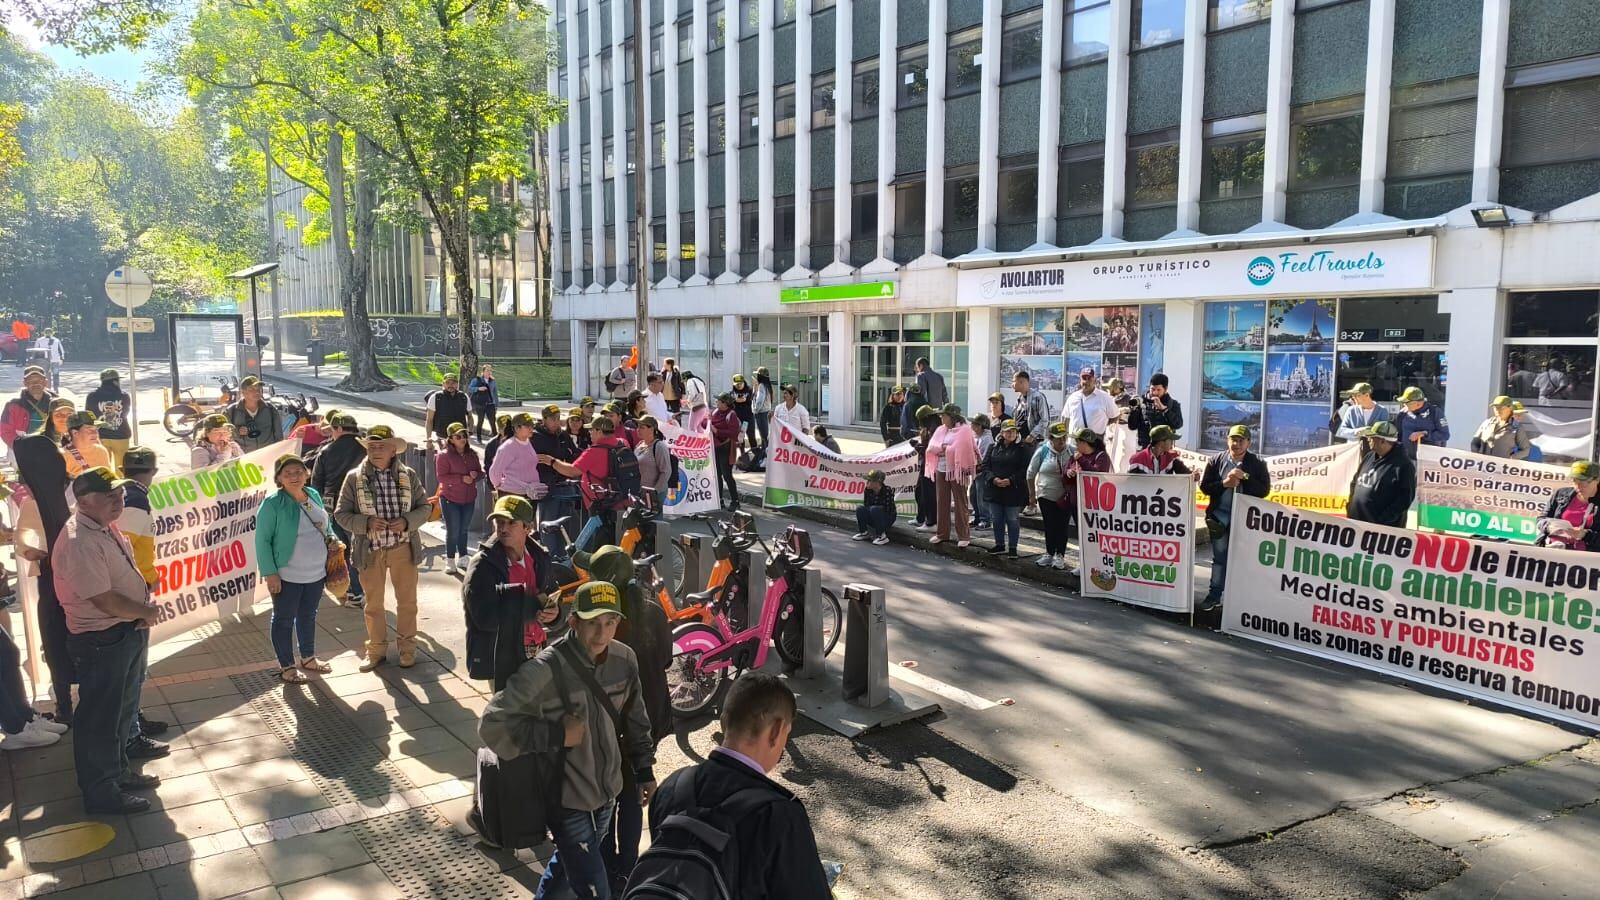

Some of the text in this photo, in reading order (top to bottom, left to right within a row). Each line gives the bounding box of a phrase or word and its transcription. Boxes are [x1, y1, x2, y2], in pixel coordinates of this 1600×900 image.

[1000, 269, 1065, 288] AVOLARTUR
[1093, 260, 1211, 275] GRUPO TURÍSTICO
[774, 447, 818, 469] 29.000
[1440, 457, 1566, 482] COP16 tengan
[147, 460, 268, 511] orte Unido:
[809, 475, 866, 494] 2.000.00
[1270, 467, 1328, 479] egalidad
[1424, 470, 1553, 497] Ni los páramos
[1083, 475, 1182, 518] NO más
[1269, 482, 1294, 493] egal
[1474, 494, 1548, 512] estamos
[186, 507, 199, 529] el
[1083, 512, 1186, 537] Violaciones
[1450, 510, 1538, 535] NO AL D
[156, 514, 257, 560] rzas vivas firma
[1087, 530, 1178, 561] al ACUERDO
[1246, 506, 1356, 548] Gobierno
[1360, 529, 1413, 558] que
[1412, 532, 1471, 574] NO
[1469, 544, 1500, 575] le
[1102, 554, 1177, 584] de Escazú
[1258, 538, 1288, 569] el
[1292, 545, 1394, 592] medio
[177, 589, 197, 615] de
[200, 571, 256, 609] Reserva
[1280, 574, 1584, 657] Medidas ambientales
[1241, 612, 1289, 638] como
[1293, 622, 1322, 645] las
[1326, 632, 1384, 661] zonas
[1388, 644, 1415, 669] de
[1418, 652, 1506, 692] reserva
[1312, 604, 1535, 673] FALSAS Y POPULISTAS
